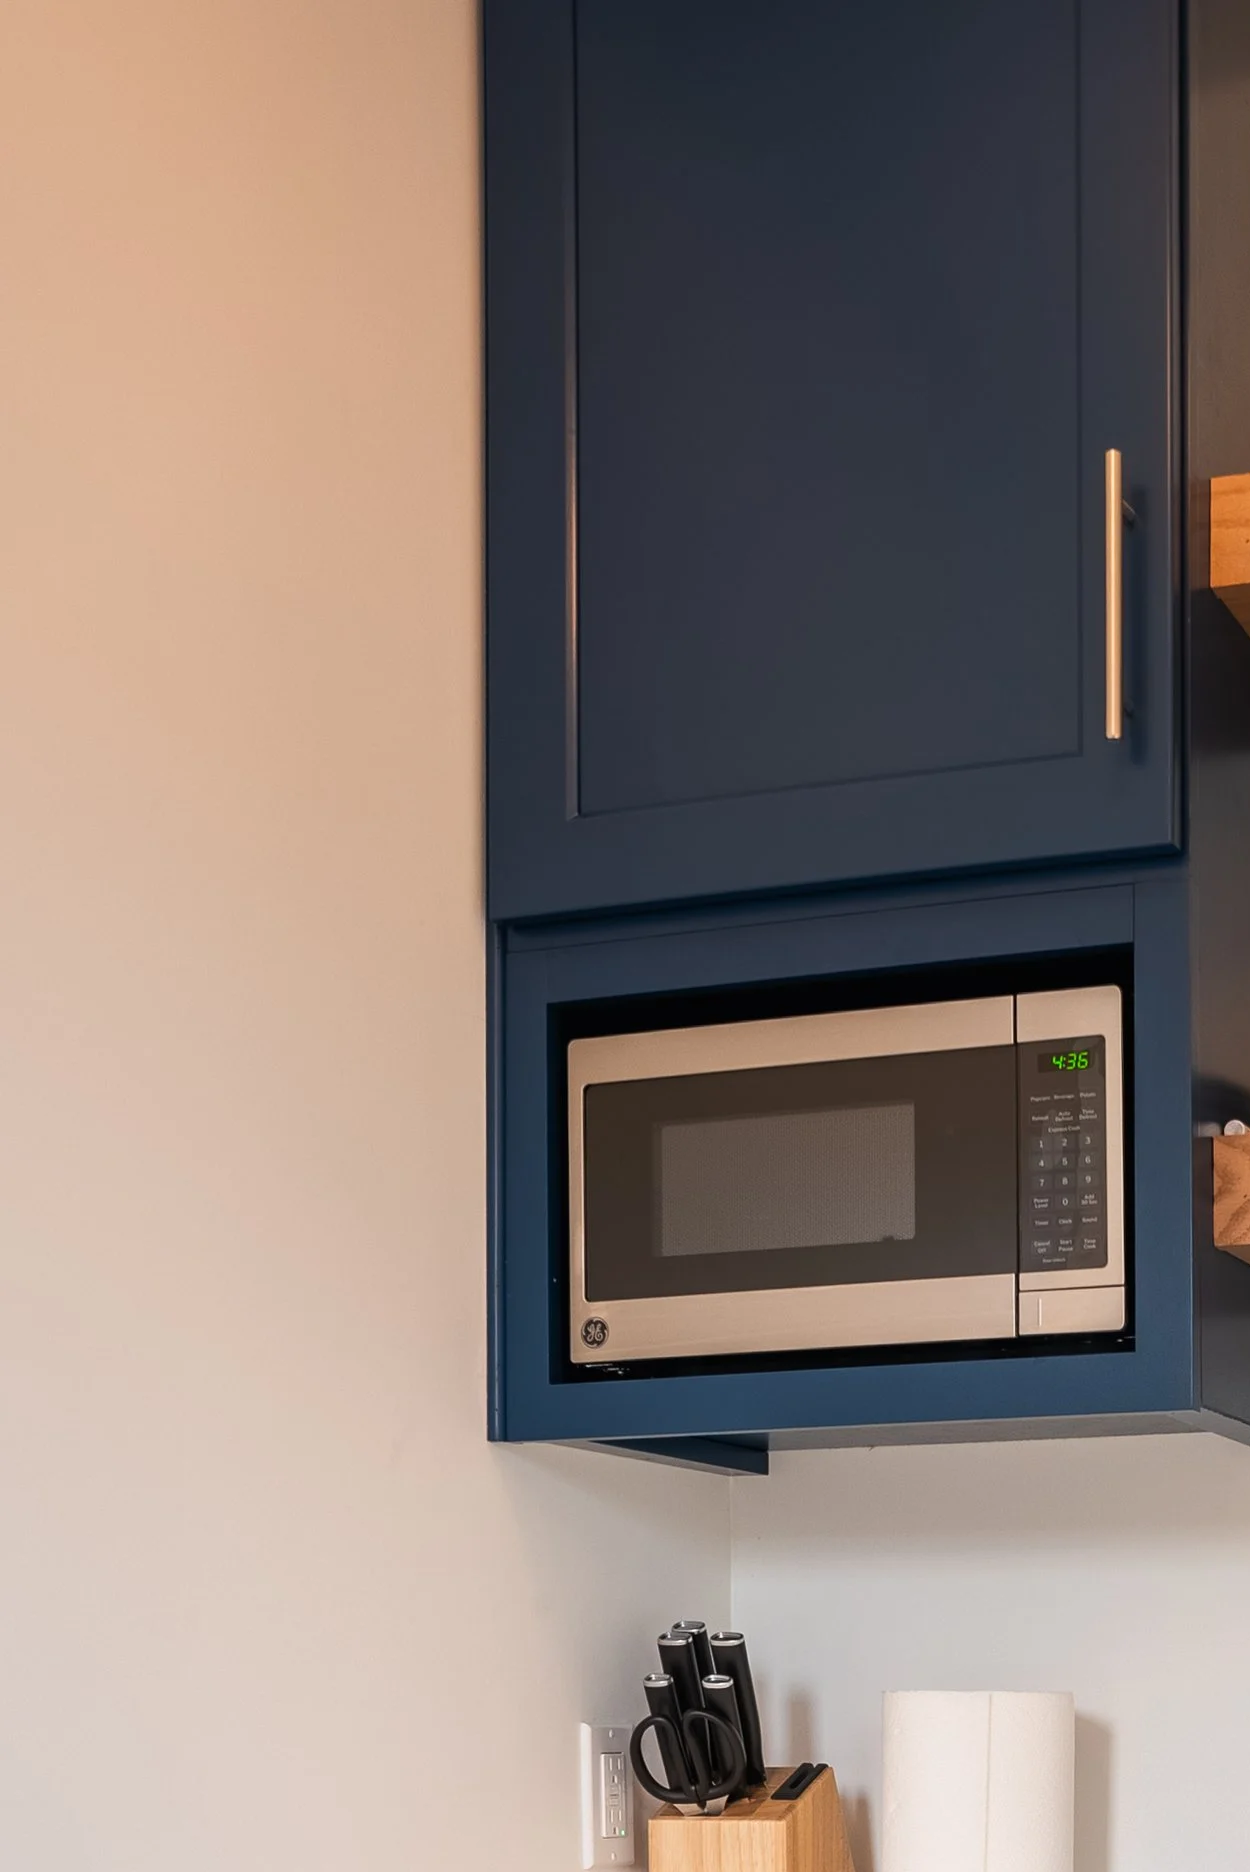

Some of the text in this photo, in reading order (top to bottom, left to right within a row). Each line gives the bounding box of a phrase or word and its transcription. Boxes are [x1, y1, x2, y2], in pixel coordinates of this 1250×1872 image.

[1052, 1051, 1089, 1070] 4:36
[1039, 1139, 1044, 1148] 1
[1061, 1138, 1068, 1146] 2
[1084, 1136, 1091, 1144] 3
[1038, 1159, 1045, 1167] 4
[1062, 1157, 1068, 1166] 5
[1084, 1155, 1091, 1164] 6
[1039, 1179, 1045, 1187] 7
[1062, 1176, 1068, 1185] 8
[1085, 1175, 1091, 1183] 9
[1062, 1197, 1069, 1206] 0
